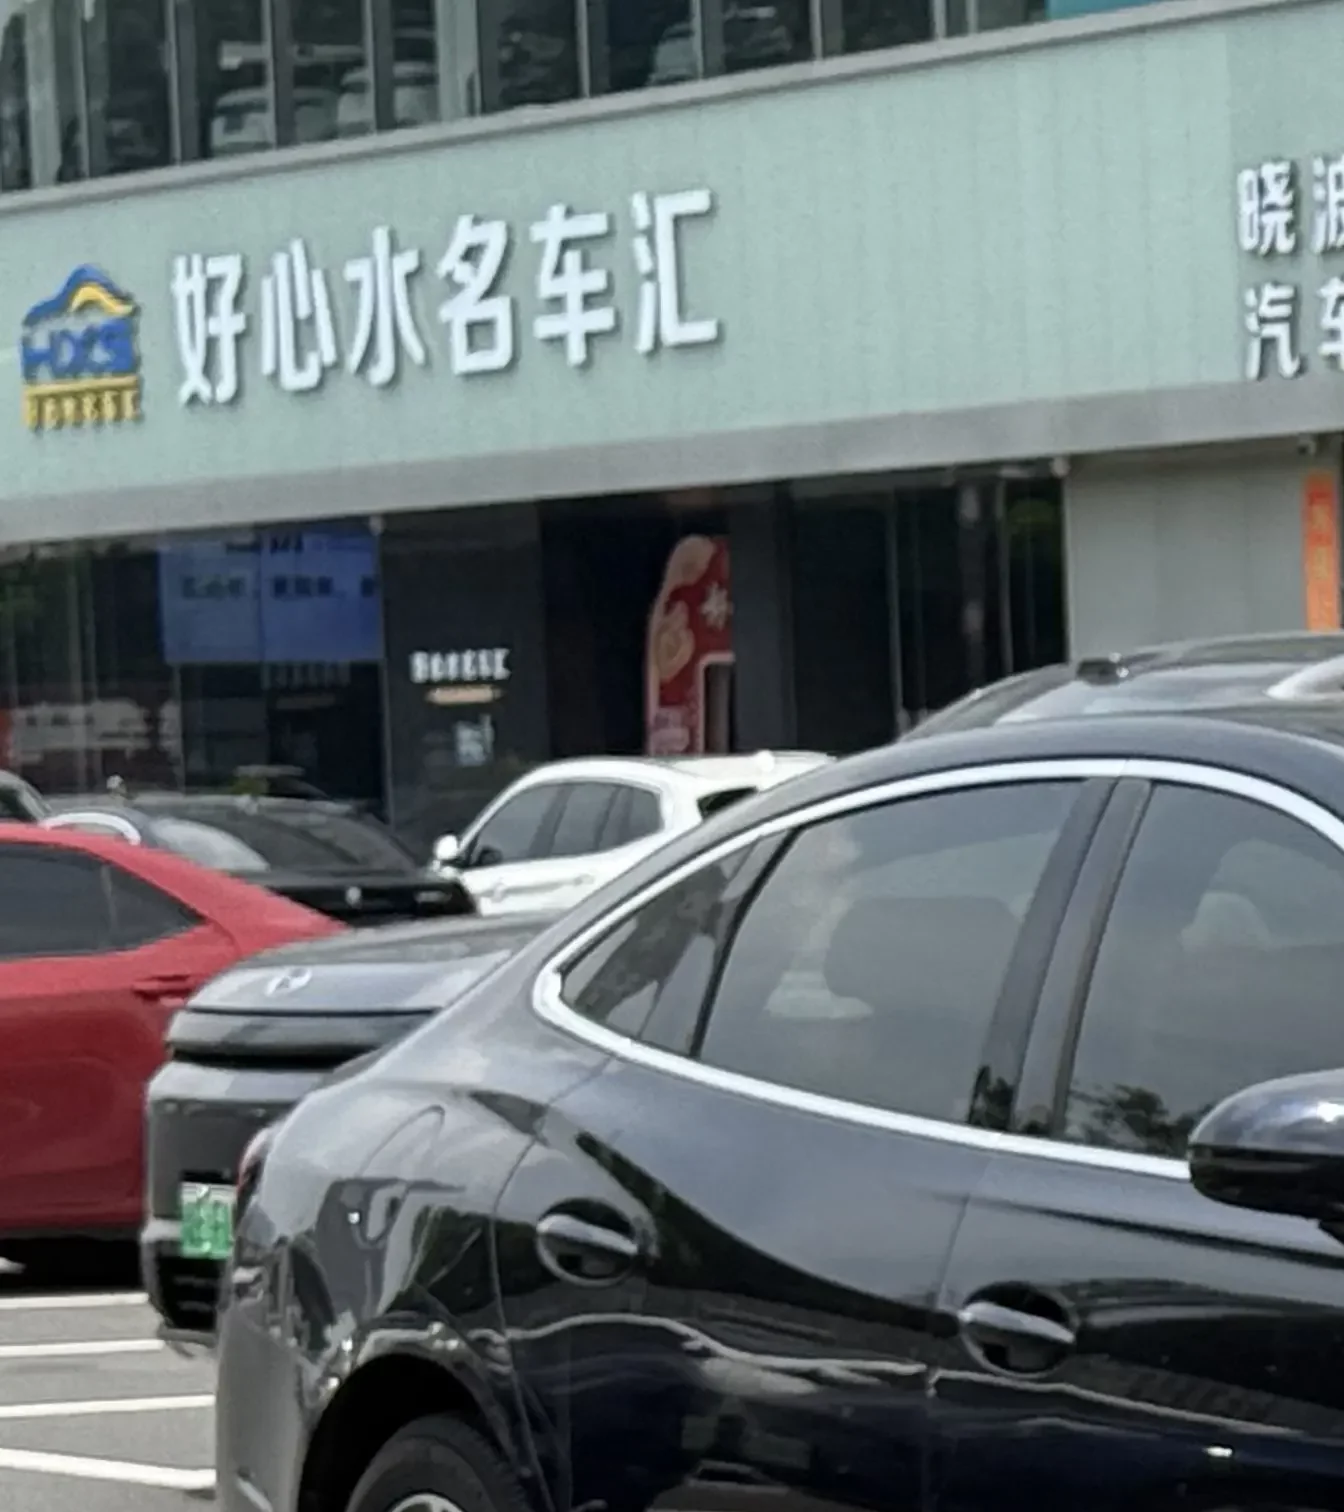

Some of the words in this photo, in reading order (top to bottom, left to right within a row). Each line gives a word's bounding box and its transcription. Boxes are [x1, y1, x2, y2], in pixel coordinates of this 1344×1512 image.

[170, 188, 718, 406] 好心水名车汇
